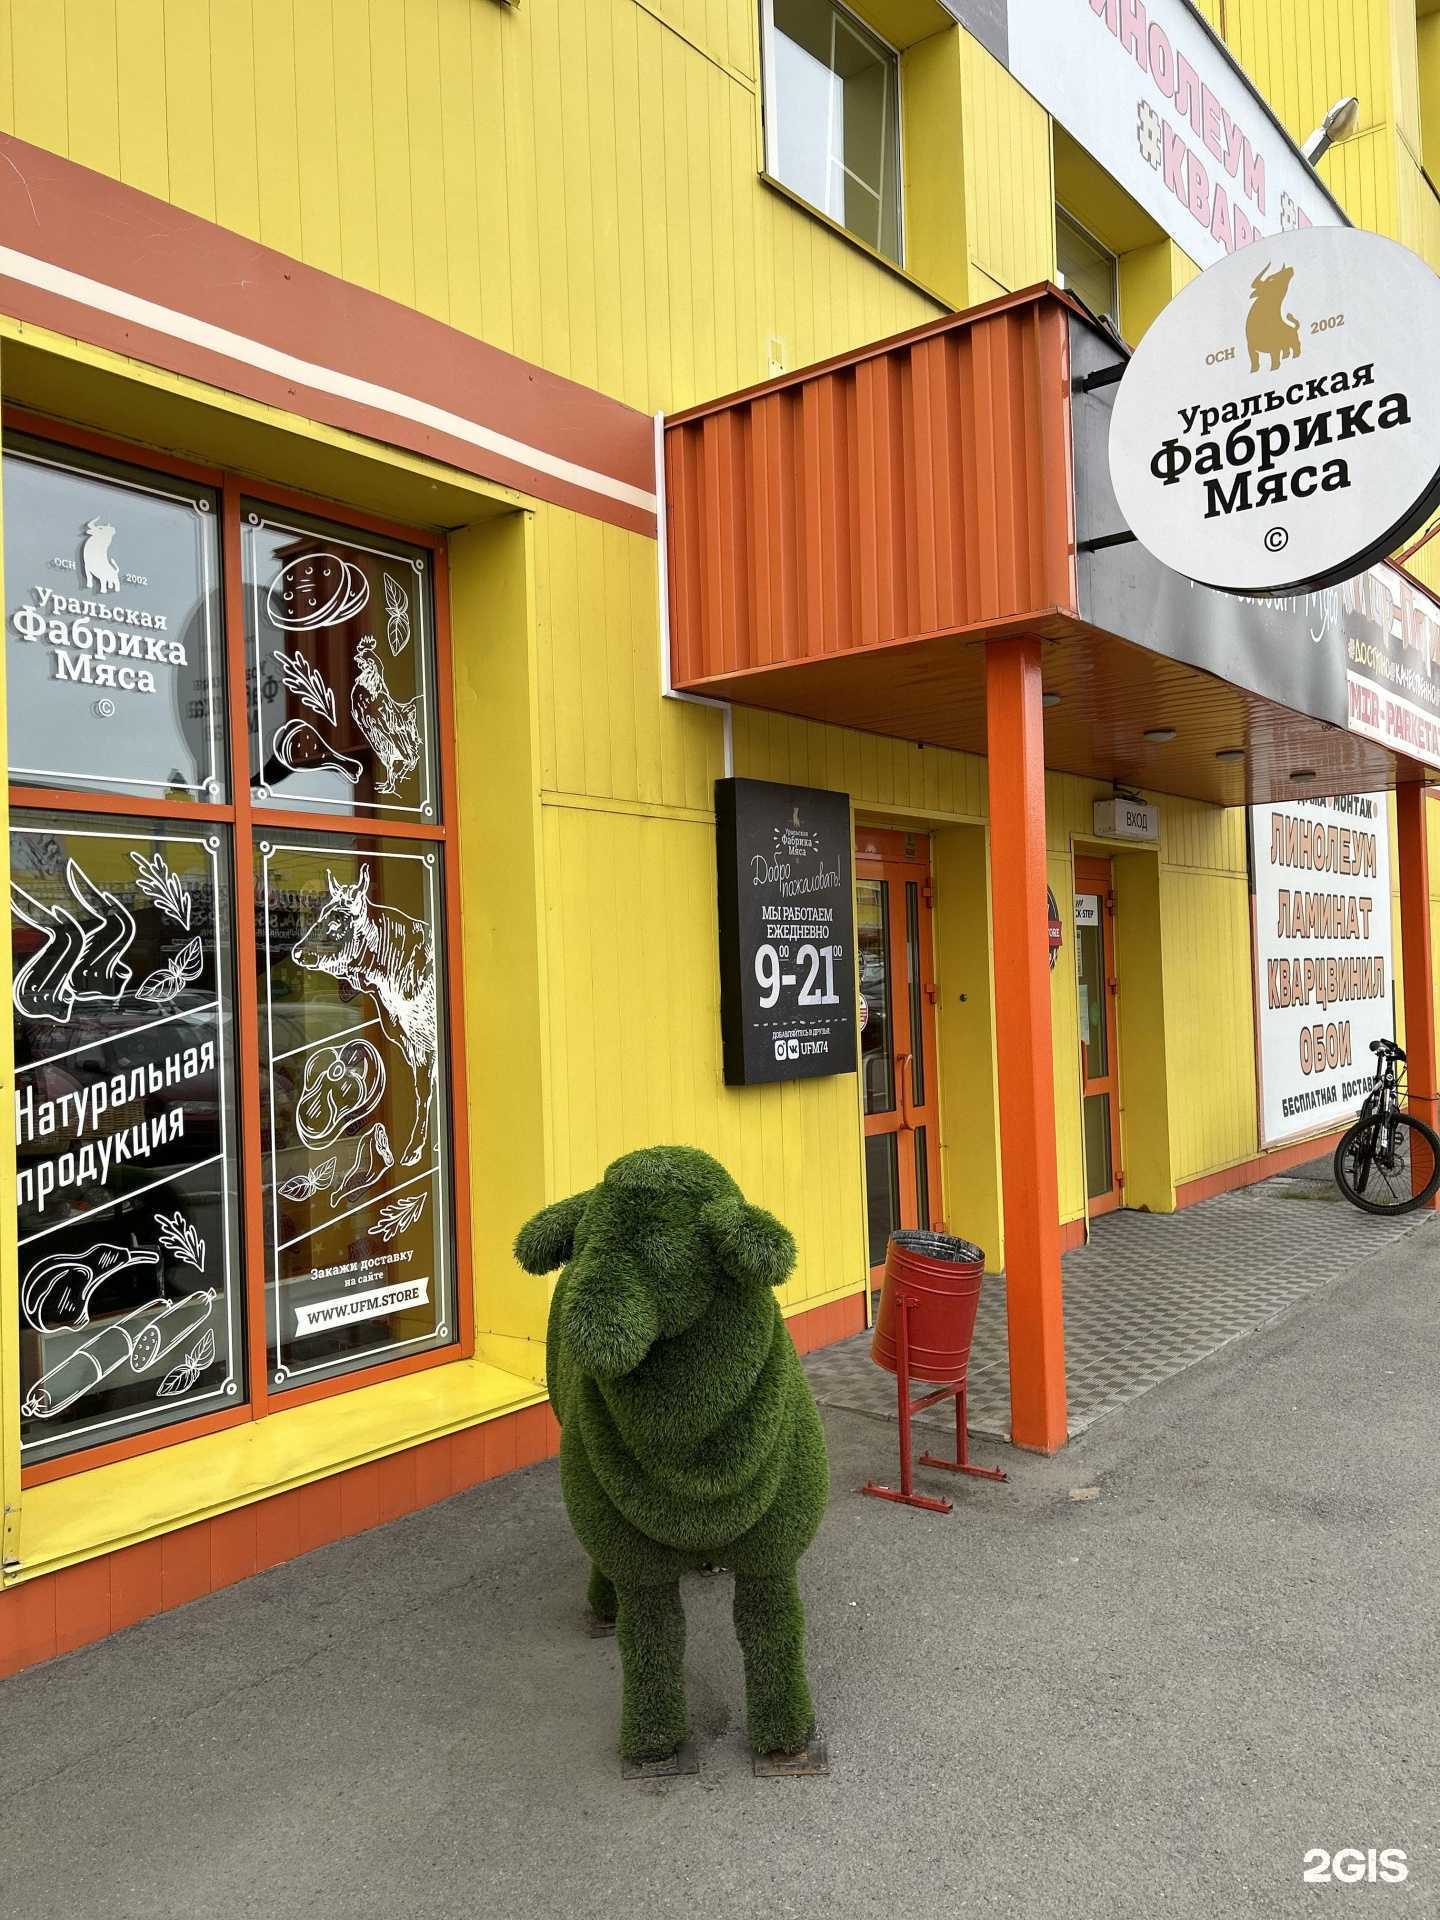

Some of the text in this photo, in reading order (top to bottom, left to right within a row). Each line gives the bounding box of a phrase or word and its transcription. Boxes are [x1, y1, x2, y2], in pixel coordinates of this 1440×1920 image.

[1137, 99, 1262, 255] #КВАР
[1205, 314, 1345, 366] ОСН 2002
[1177, 363, 1375, 435] Уральская
[1150, 392, 1411, 486] Фабрика
[1203, 457, 1351, 519] Мяса
[54, 557, 148, 585] ОСН 2002
[35, 585, 168, 630] Уральская
[13, 605, 188, 666] Фабрика
[55, 649, 156, 693] Мяса
[781, 834, 812, 847] Фабрика
[1126, 811, 1148, 832] ВХОД
[788, 845, 807, 856] Мяса
[1270, 811, 1377, 879] ЛИНОЛЕУМ
[751, 851, 791, 893] Добро
[762, 906, 833, 921] МЫ РАБОТАЕМ
[767, 924, 829, 942] ЕЖЕДНЕВНО
[1277, 889, 1373, 940] ЛАМИНАТ
[1267, 955, 1385, 1011] КВАРЦВИНИЛ
[800, 1041, 829, 1055] UFM74
[1299, 1020, 1352, 1076] ОБОИ
[15, 1040, 215, 1146] Натуральная
[1282, 1085, 1338, 1118] БЕСПЛАТНАЯ
[17, 1107, 184, 1213] продукция
[310, 1249, 414, 1281] Закажи доставку
[344, 1271, 384, 1287] на сайте
[307, 1287, 420, 1325] WWW.UFM.STORE
